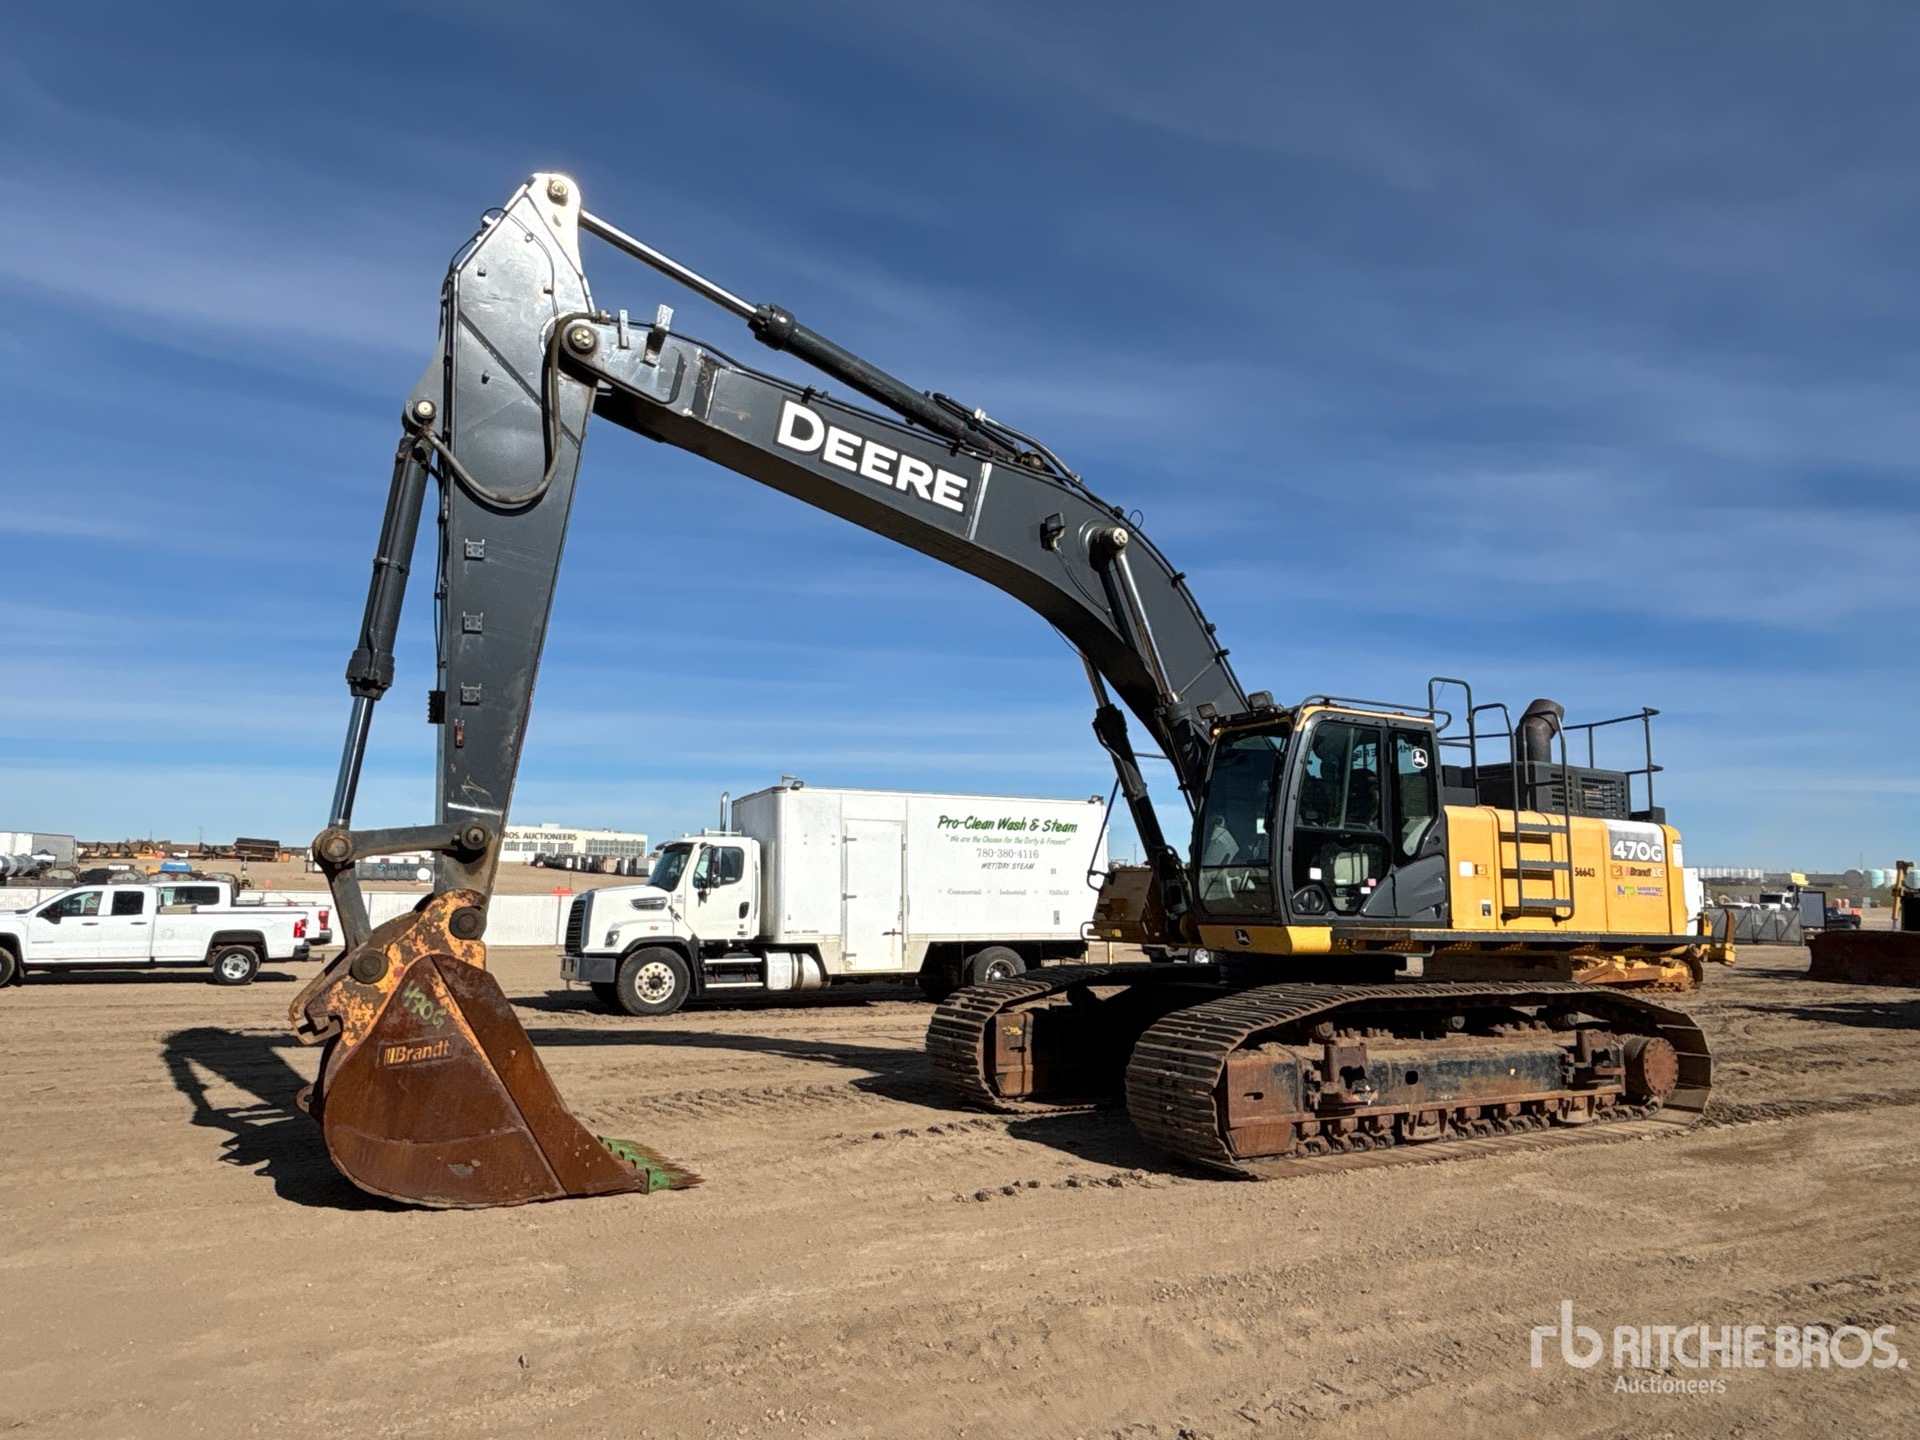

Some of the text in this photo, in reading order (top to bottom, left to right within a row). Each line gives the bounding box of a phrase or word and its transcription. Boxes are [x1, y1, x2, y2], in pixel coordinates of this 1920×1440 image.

[777, 400, 968, 512] DEERE
[937, 815, 1078, 833] Pro-Clean Wash & Steam
[504, 832, 578, 841] ROS. AUCTIONEERS
[976, 848, 1039, 859] 780-380-4116
[1613, 840, 1663, 862] 470G
[1574, 867, 1595, 878] 56643
[396, 1040, 449, 1064] Brandt
